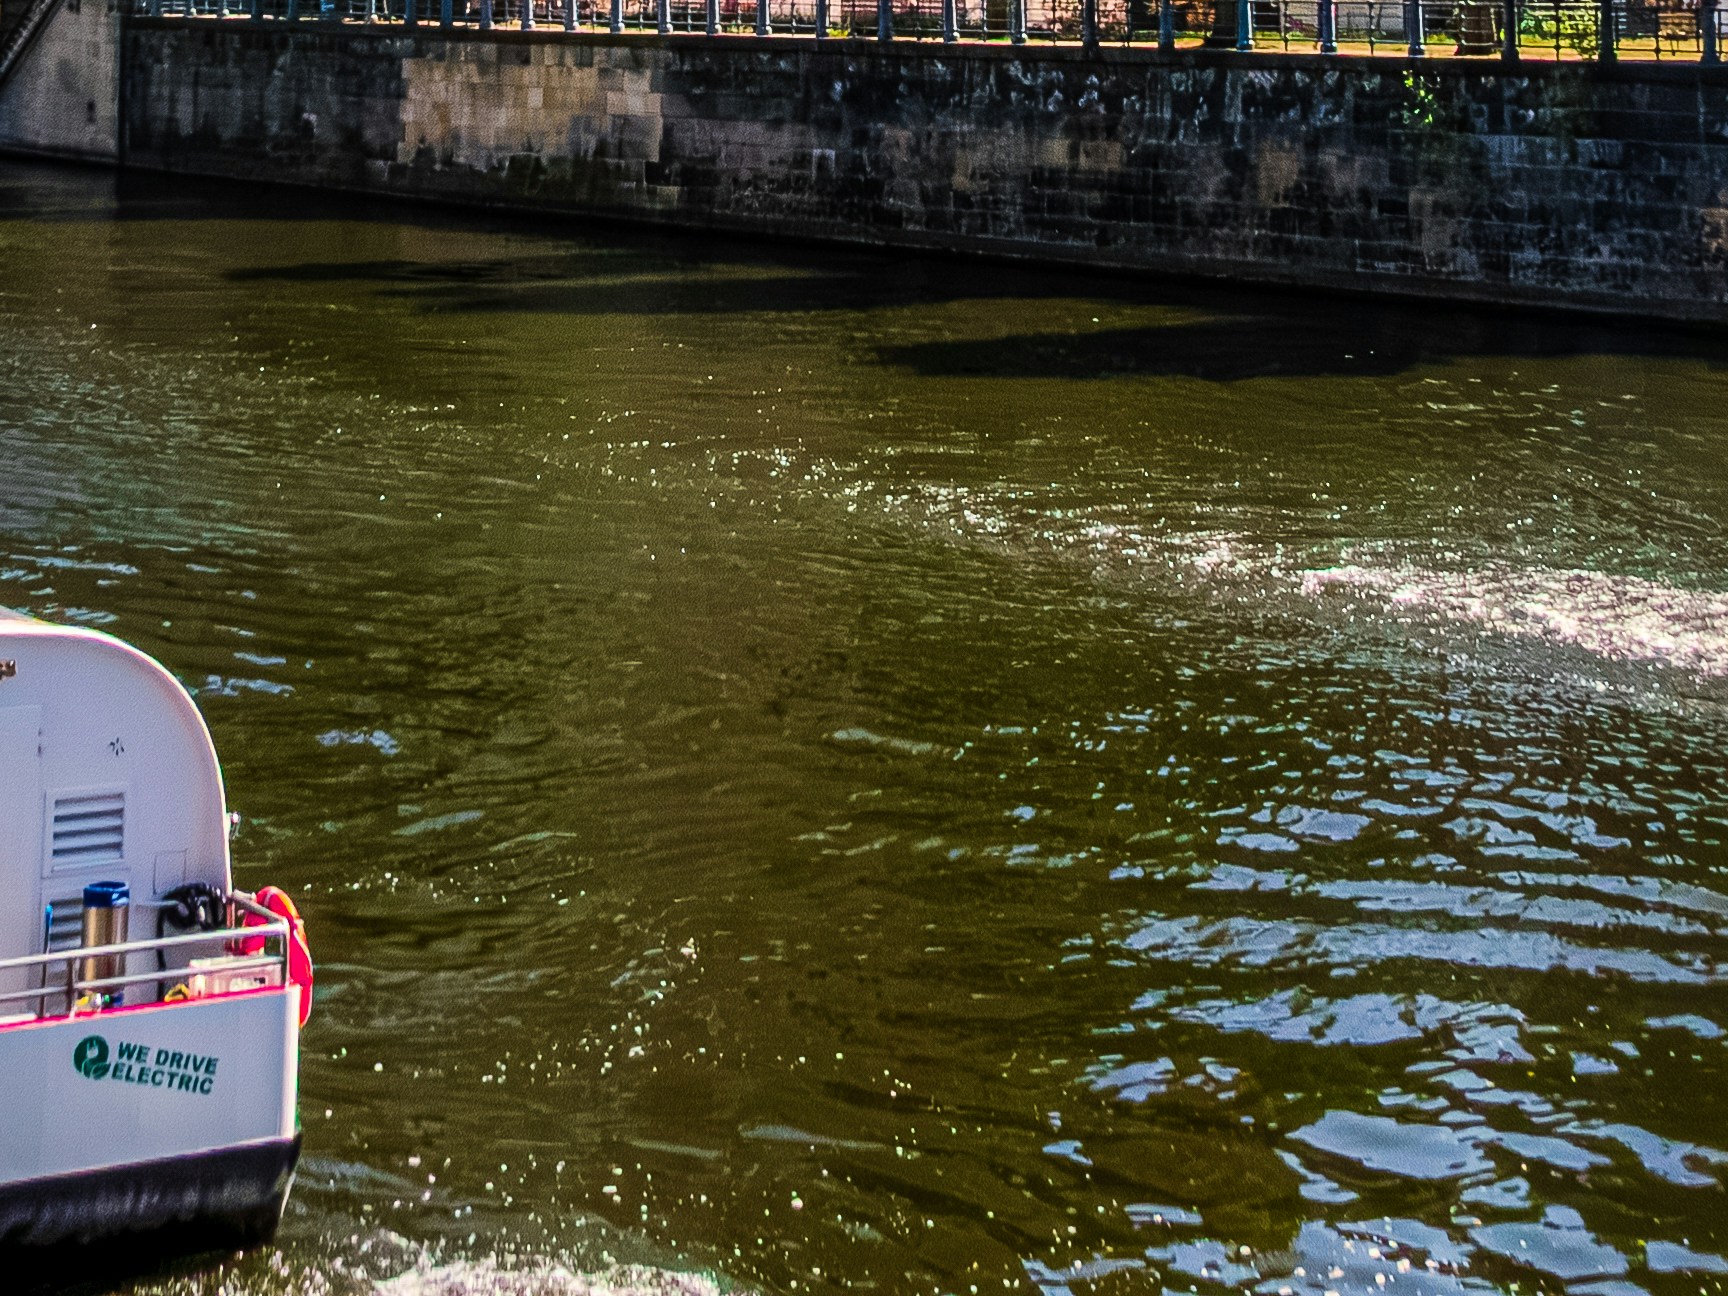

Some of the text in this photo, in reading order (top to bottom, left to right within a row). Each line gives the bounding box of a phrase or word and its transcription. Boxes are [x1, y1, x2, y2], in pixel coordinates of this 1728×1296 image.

[116, 1041, 220, 1076] WE DRIVE
[110, 1061, 215, 1096] ELECTRIC
